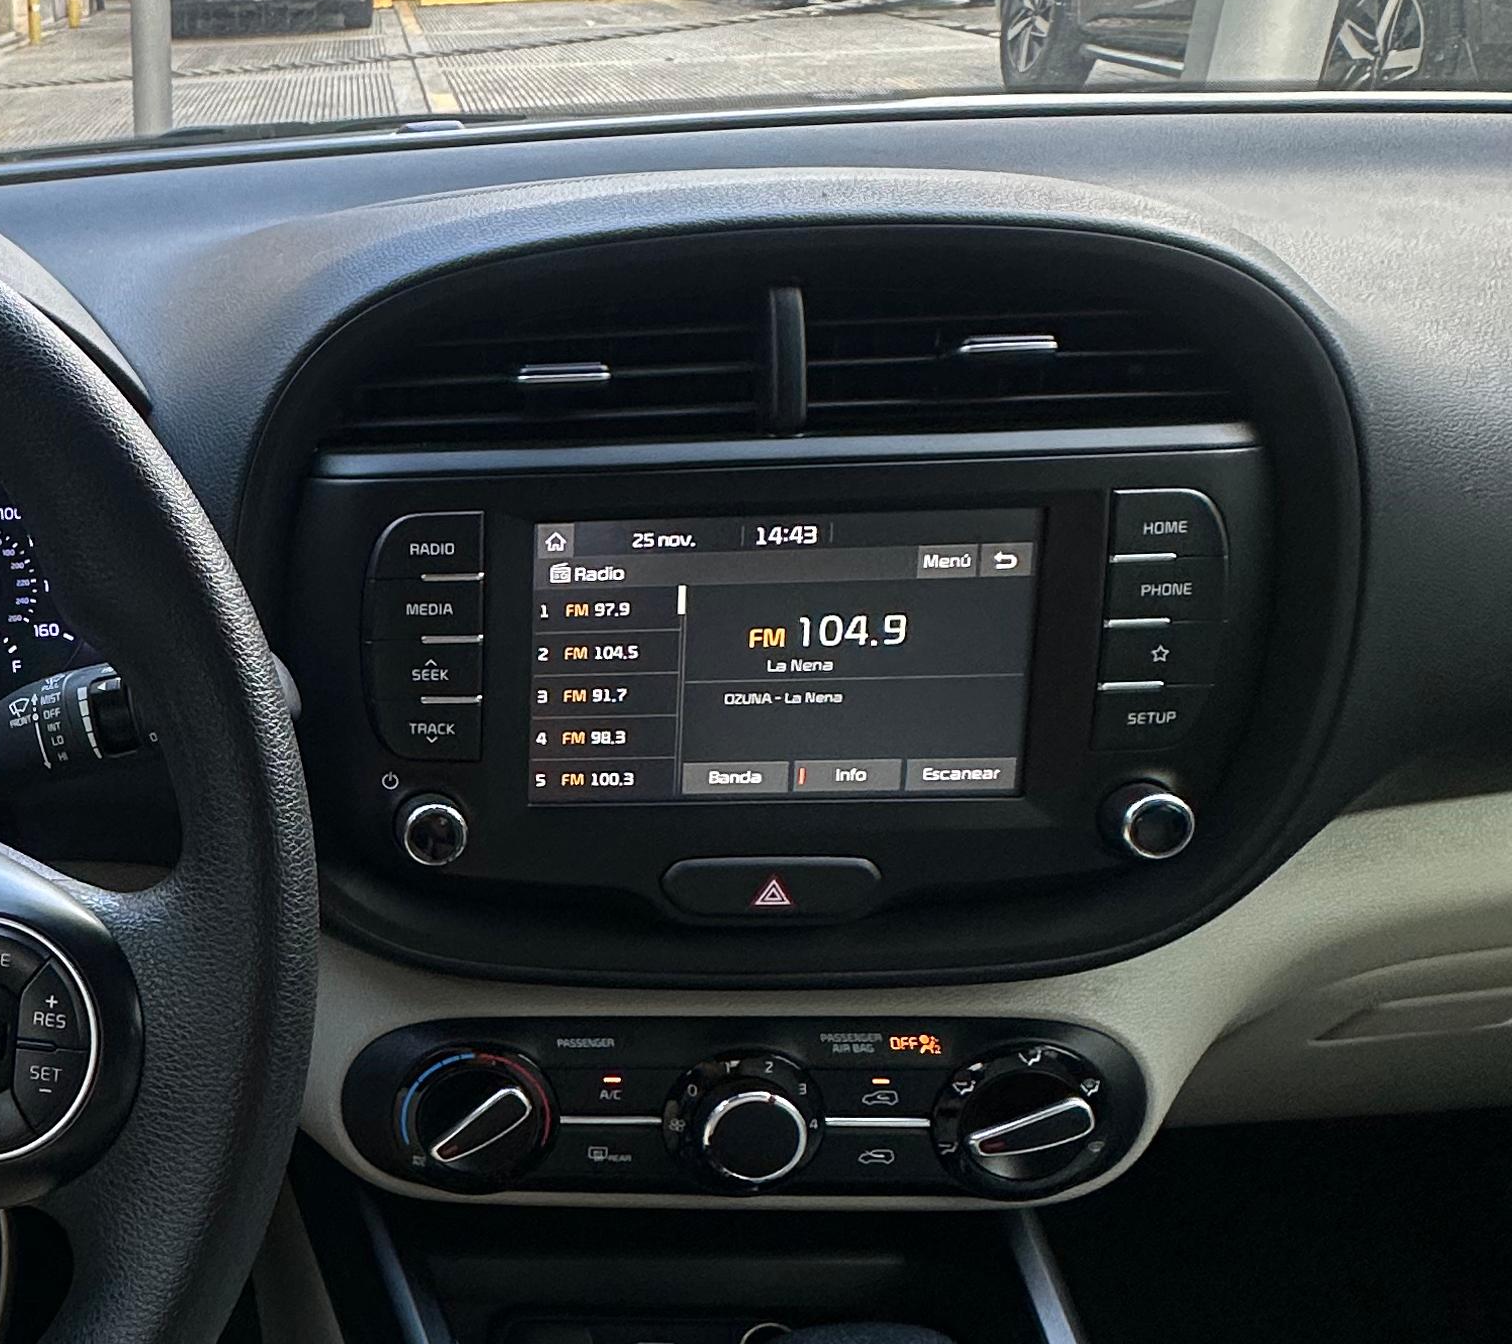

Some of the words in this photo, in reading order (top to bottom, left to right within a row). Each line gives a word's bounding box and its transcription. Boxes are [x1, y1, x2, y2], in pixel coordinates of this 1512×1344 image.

[755, 525, 818, 546] 14:43
[1142, 520, 1189, 536] HOME
[632, 533, 654, 549] 25
[658, 534, 697, 548] nov.
[409, 542, 455, 556] RADIO
[923, 553, 972, 569] Menú
[574, 566, 626, 582] Radio
[1140, 582, 1193, 597] PHONE
[406, 603, 454, 616] MEDIA
[540, 604, 549, 618] 1
[565, 603, 589, 618] FM
[594, 602, 630, 618] 97.9
[33, 623, 60, 637] 160
[748, 627, 786, 648] FM
[798, 613, 908, 649] 104.9
[537, 648, 549, 662] 2
[564, 646, 588, 661] FM
[594, 645, 639, 660] 104.5
[12, 659, 22, 673] F
[766, 659, 787, 673] La
[790, 658, 834, 673] Nena
[411, 669, 449, 681] SEEK
[40, 692, 61, 706] MIST
[536, 689, 548, 703] 3
[563, 689, 587, 703] FM
[592, 688, 628, 703] 91.7
[724, 692, 773, 706] OZUNA
[784, 692, 802, 706] La
[805, 691, 843, 705] Nena
[43, 707, 61, 720] OFF
[1127, 711, 1177, 726] SETUP
[409, 723, 456, 735] TRACK
[51, 735, 65, 746] LO
[536, 732, 547, 746] 4
[562, 731, 586, 745] FM
[591, 730, 627, 745] 98.3
[535, 773, 547, 787] 5
[561, 773, 585, 787] FM
[591, 772, 635, 787] 100.3
[708, 770, 763, 785] Banda
[835, 767, 868, 783] Info
[922, 767, 1001, 782] Escanear
[32, 1011, 67, 1029] RES
[556, 1037, 616, 1048] PASSENGER
[819, 1032, 884, 1043] PASSENGER
[889, 1036, 918, 1050] OFF
[853, 1043, 876, 1054] BAG
[29, 1065, 63, 1083] SET
[764, 1061, 774, 1074] 2
[599, 1089, 623, 1100] A/C
[798, 1083, 807, 1095] 3
[809, 1118, 818, 1129] 4
